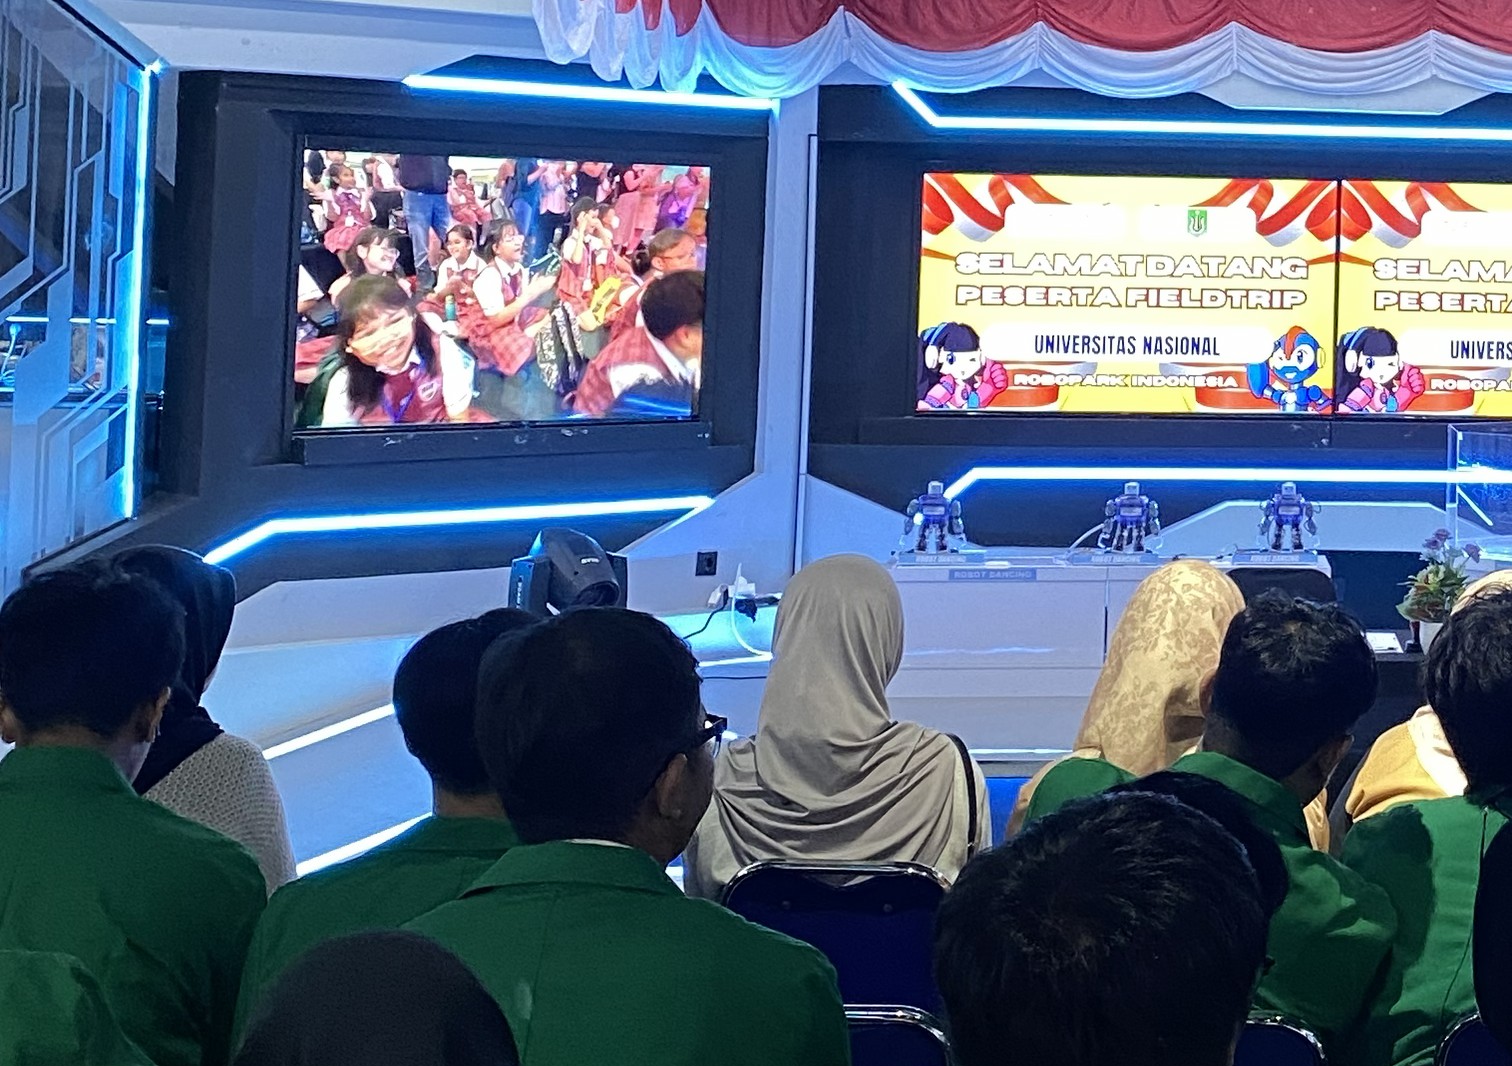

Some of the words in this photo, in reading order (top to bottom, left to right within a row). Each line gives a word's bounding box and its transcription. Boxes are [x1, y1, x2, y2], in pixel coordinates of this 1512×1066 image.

[955, 251, 1144, 277] SELAMAT
[1147, 254, 1309, 280] DATANG
[955, 285, 1122, 307] PESERTA
[1126, 287, 1307, 310] FIELDTRIP
[1034, 334, 1137, 355] UNIVERSITAS
[1143, 336, 1221, 356] NASIONAL
[1013, 373, 1129, 388] ROBOPARK
[1131, 374, 1239, 389] INDONESIA
[954, 571, 987, 579] ROBOT
